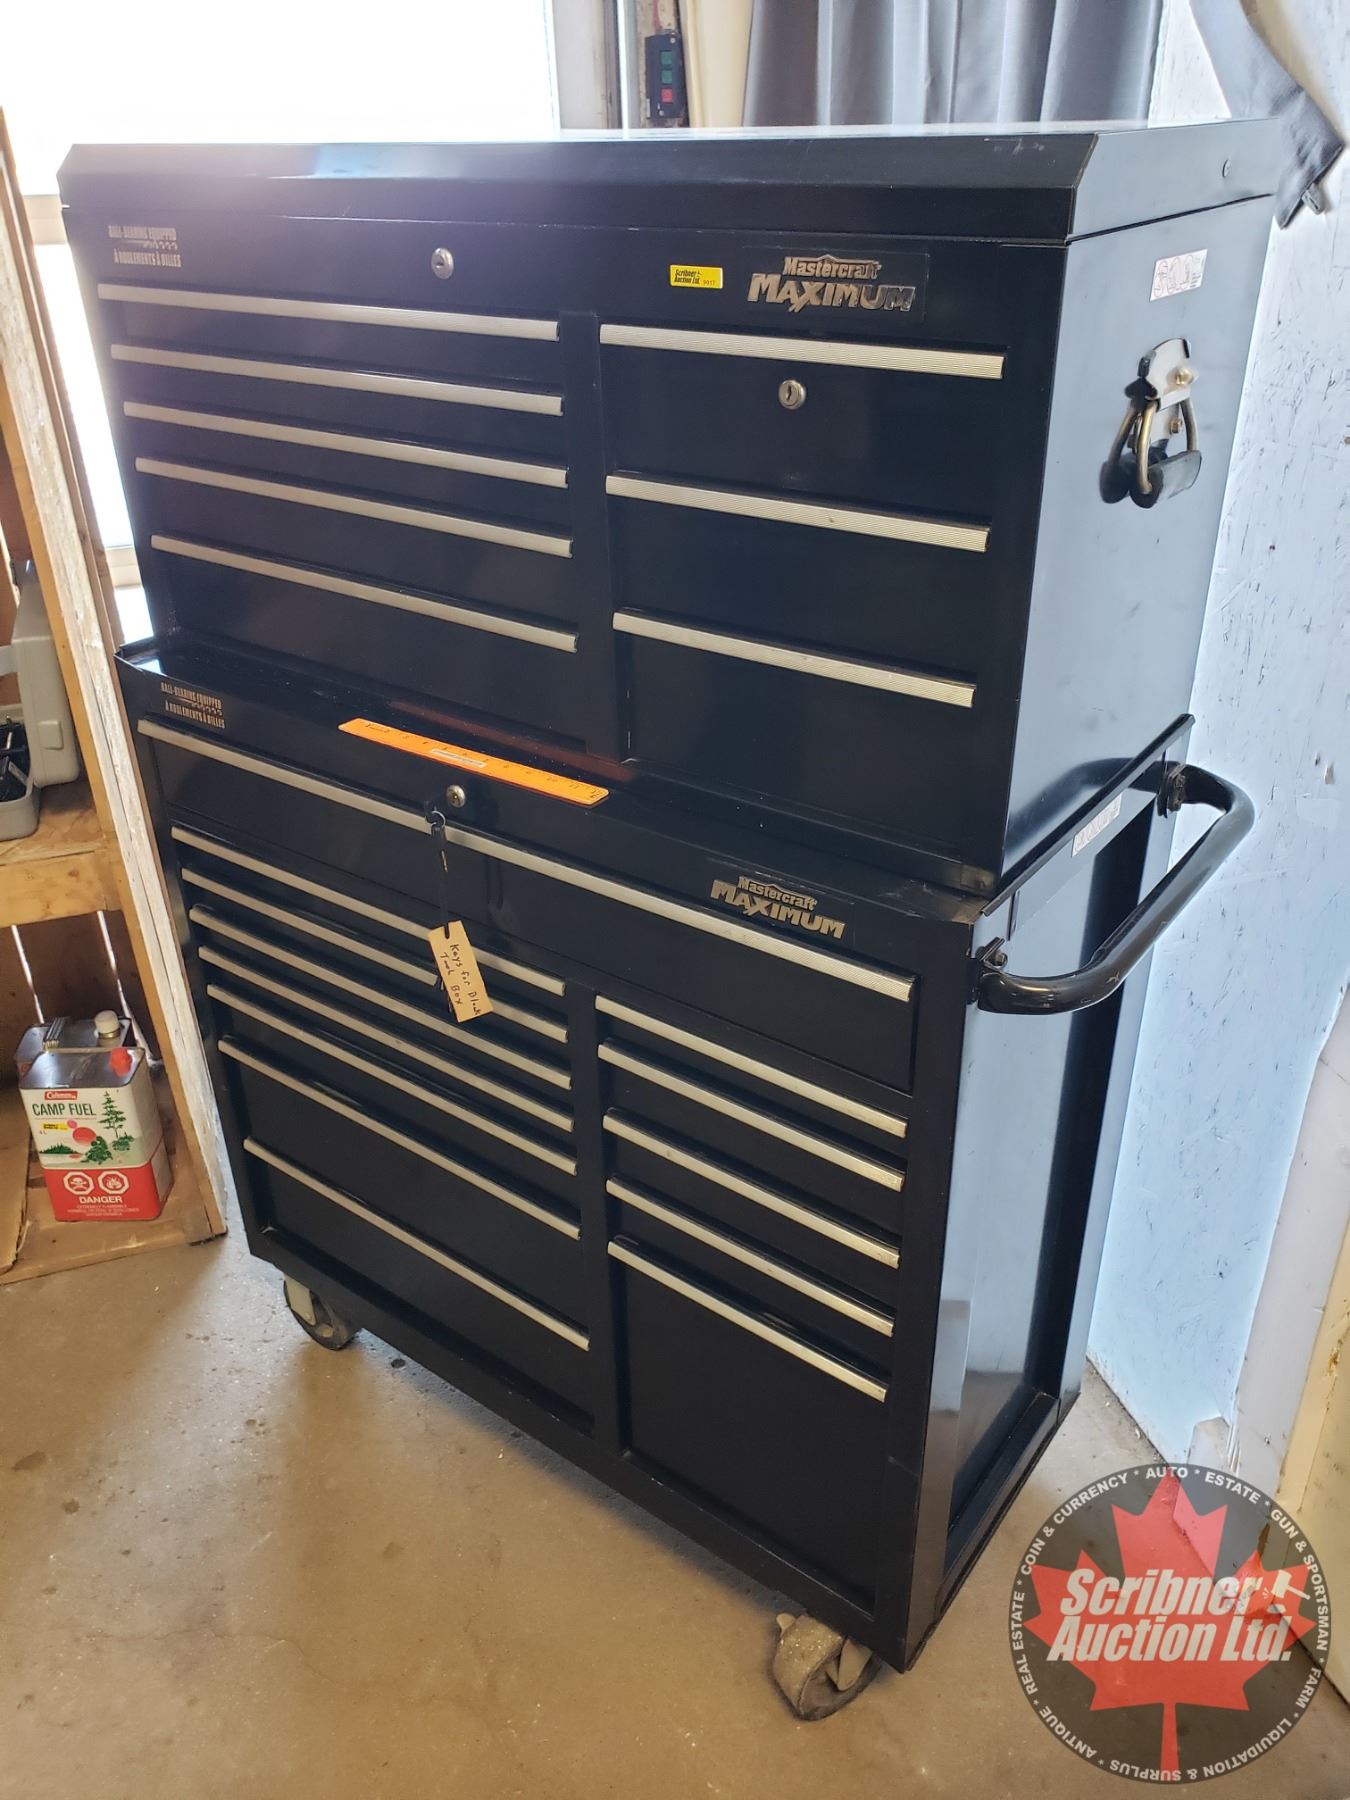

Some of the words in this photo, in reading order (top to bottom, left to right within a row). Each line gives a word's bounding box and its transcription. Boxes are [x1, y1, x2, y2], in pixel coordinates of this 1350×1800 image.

[783, 255, 883, 280] Mastercraft
[747, 273, 916, 313] MAXIMUM
[738, 875, 818, 911] Mastercraft
[710, 880, 845, 939] MAXIMUM
[450, 944, 462, 968] Keys
[461, 971, 471, 986] for
[450, 984, 464, 1005] Box
[32, 1103, 65, 1116] CAMP
[68, 1103, 97, 1116] FUEL
[79, 1196, 123, 1204] DANGER
